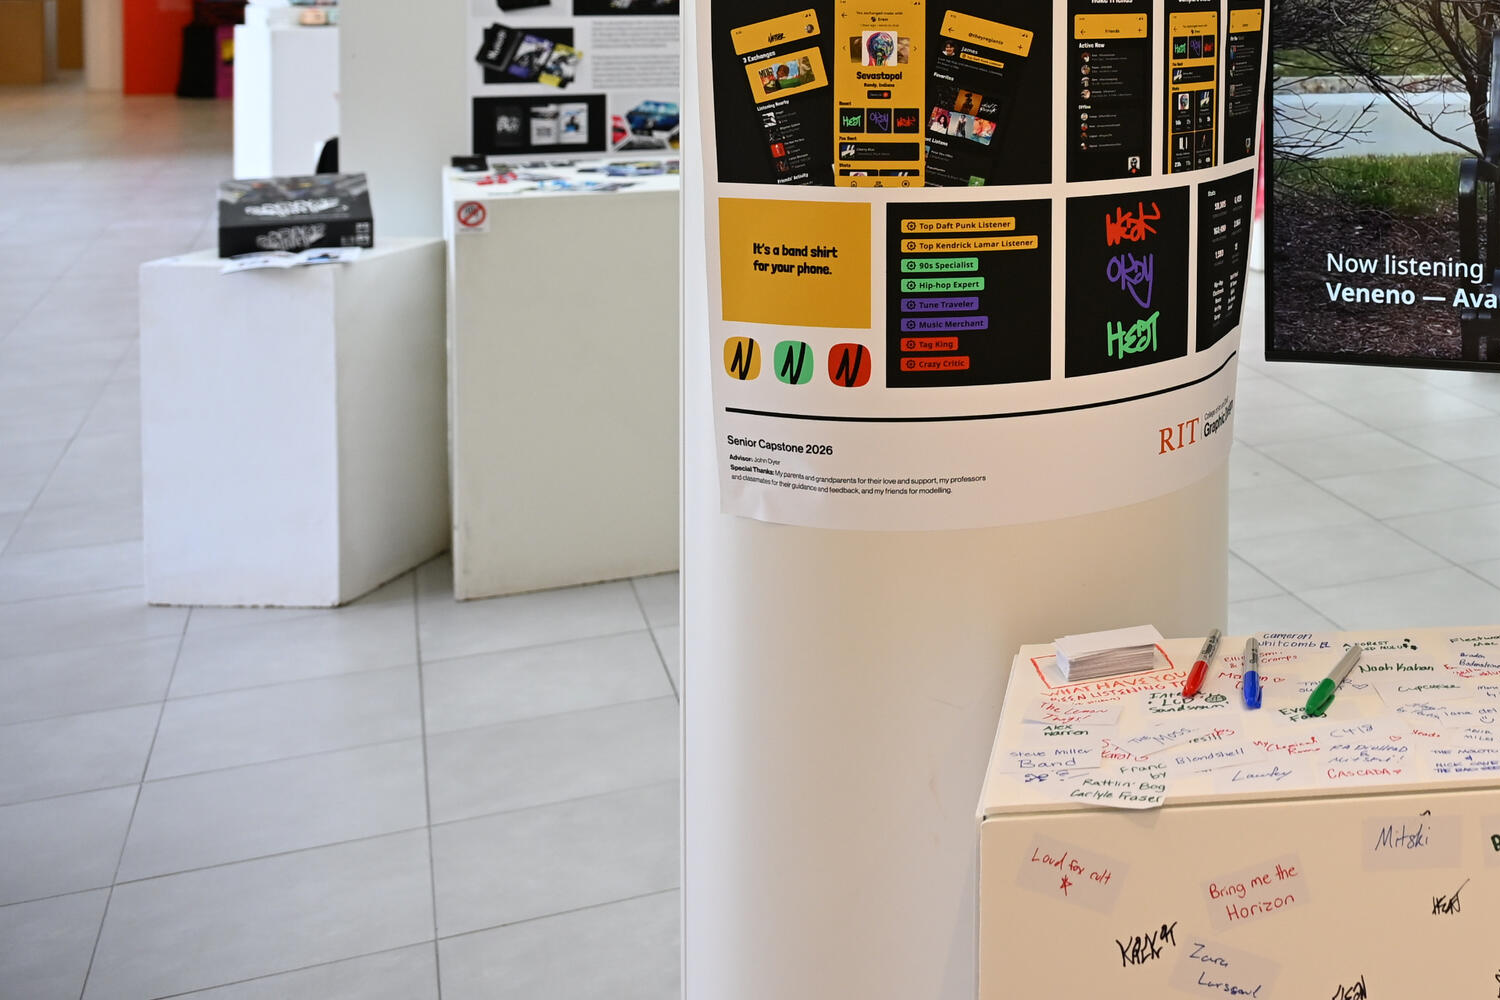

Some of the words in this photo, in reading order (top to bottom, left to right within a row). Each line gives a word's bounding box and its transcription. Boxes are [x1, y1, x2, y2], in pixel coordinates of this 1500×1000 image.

[856, 71, 902, 82] Sevastopol
[920, 223, 935, 231] Top
[978, 220, 1011, 229] Listener
[753, 242, 770, 255] It's
[772, 247, 780, 255] a
[782, 244, 808, 257] band
[810, 245, 838, 258] shirt
[920, 242, 934, 250] Top
[936, 241, 972, 249] Kendrick
[974, 240, 999, 248] Lamar
[1001, 239, 1034, 247] Listener
[753, 260, 769, 271] for
[770, 264, 795, 274] your
[797, 262, 832, 276] phone.
[935, 261, 974, 270] Specialist
[1327, 253, 1378, 274] Now
[1384, 254, 1484, 284] listening
[920, 282, 951, 290] Hip-hop
[953, 281, 980, 289] Expert
[1325, 282, 1416, 305] Veneno
[920, 301, 939, 309] Tune
[941, 300, 974, 308] Traveler
[919, 321, 942, 329] Music
[944, 320, 984, 328] Merchant
[919, 341, 933, 350] Tag
[935, 340, 954, 349] King
[919, 361, 941, 369] Crazy
[1204, 414, 1225, 437] Graphic
[1158, 417, 1200, 455] RIT
[727, 435, 756, 448] Senior
[758, 439, 804, 453] Capstone
[806, 444, 833, 455] 2026
[1359, 663, 1394, 673] Noah
[1048, 685, 1090, 696] WHAT
[1096, 678, 1147, 690] HAVE
[1090, 684, 1166, 698] LISTENING
[1020, 758, 1076, 768] Band
[1327, 768, 1391, 779] CASCADA
[1374, 824, 1431, 851] Mitski
[1209, 881, 1246, 900] Bring
[1251, 872, 1272, 888] me
[1275, 863, 1299, 881] the
[1225, 893, 1296, 921] Horizon
